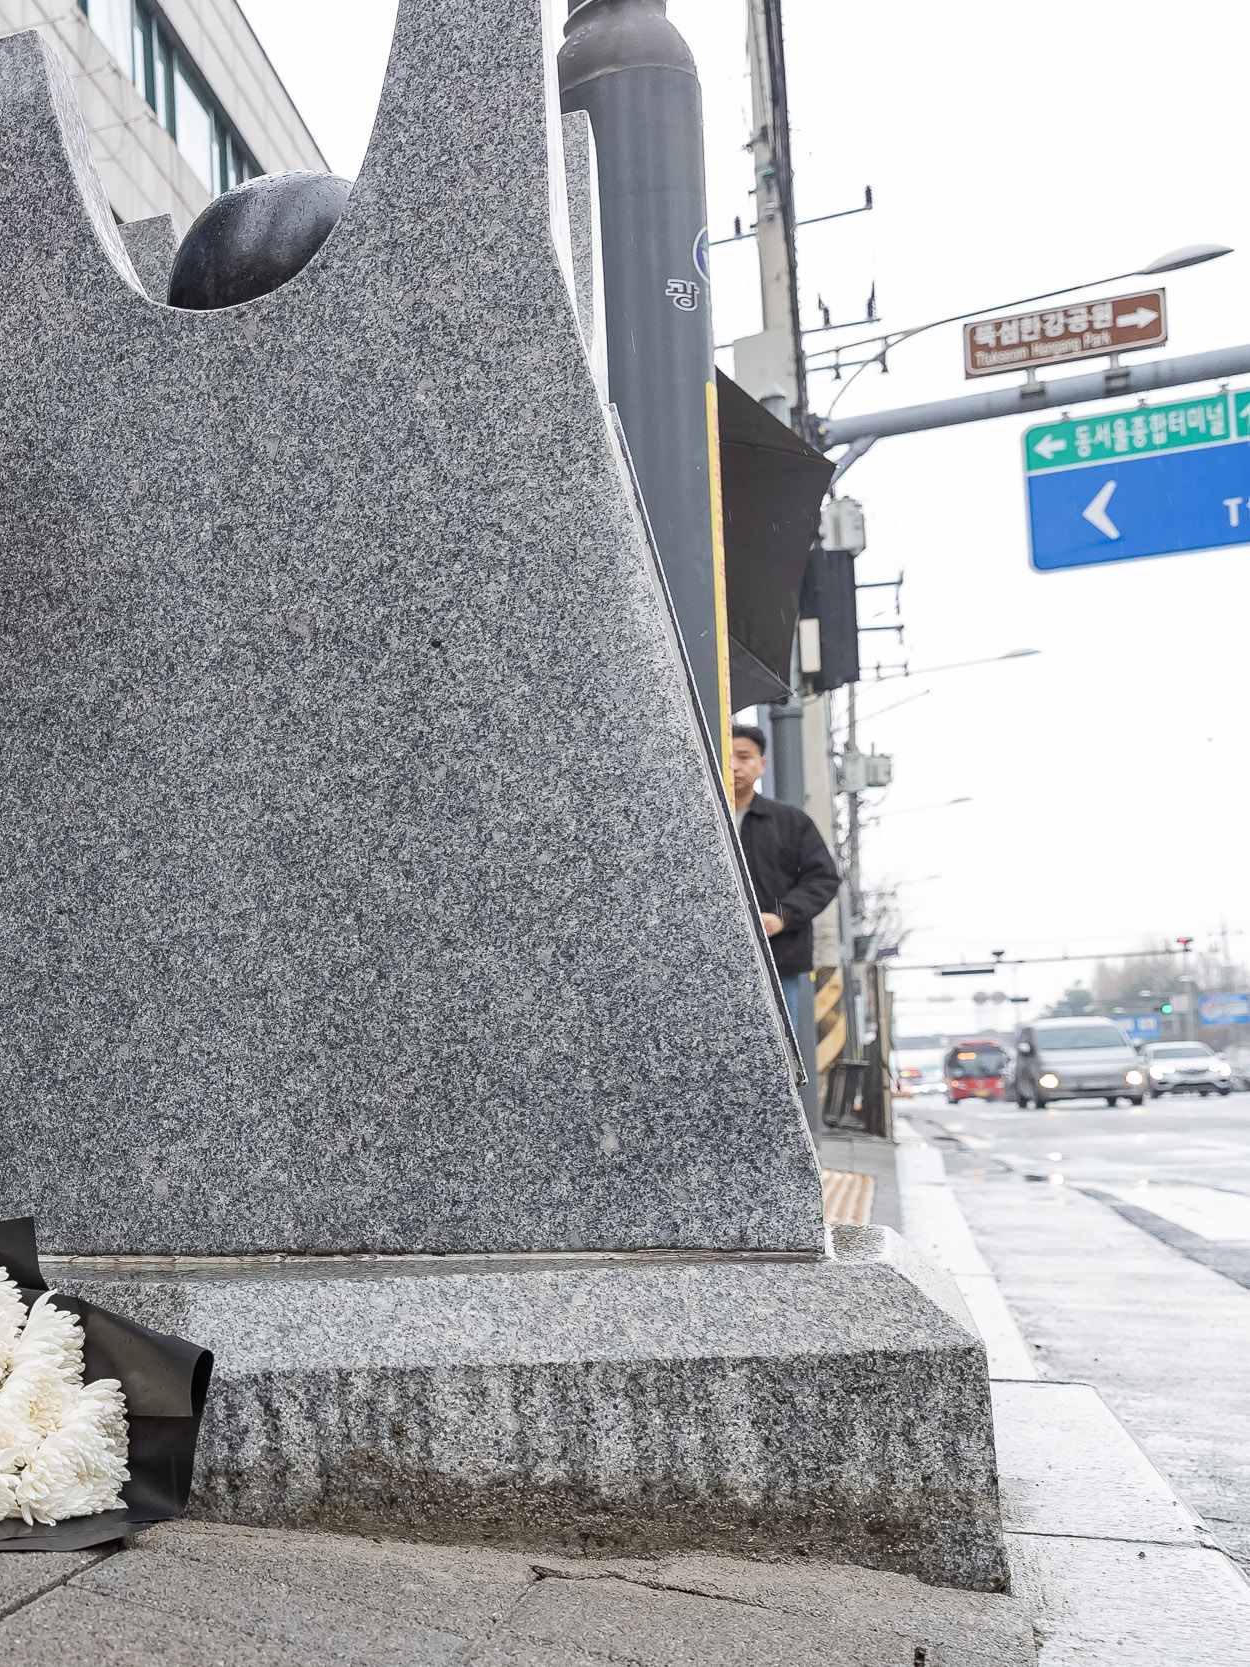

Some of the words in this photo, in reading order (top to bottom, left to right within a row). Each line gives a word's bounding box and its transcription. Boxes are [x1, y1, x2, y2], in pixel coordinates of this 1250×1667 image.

[973, 302, 1114, 348] 뚝섬한강공원
[1083, 330, 1112, 349] Park
[1074, 402, 1226, 458] 동서울종합터미널
